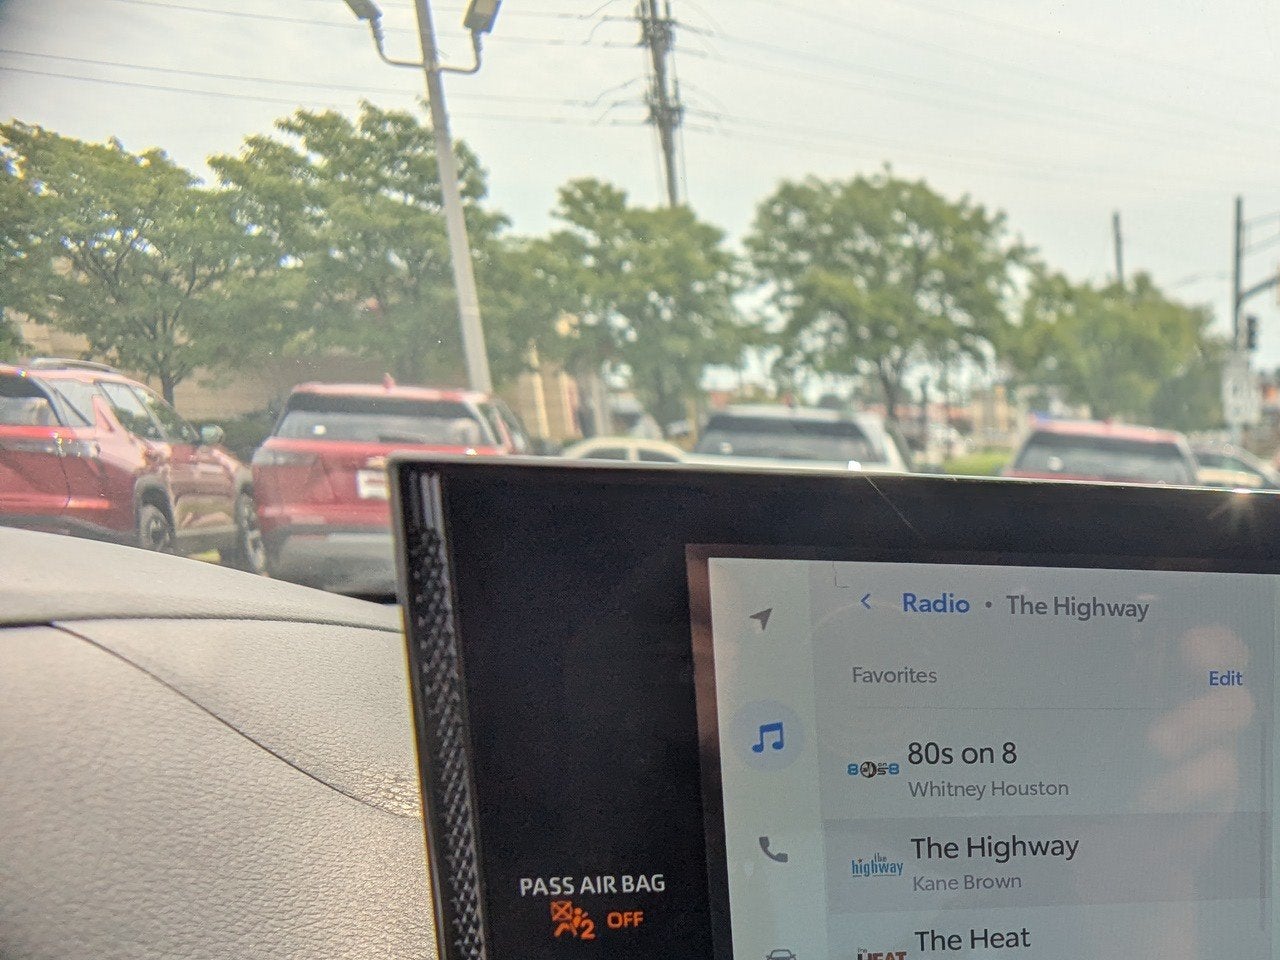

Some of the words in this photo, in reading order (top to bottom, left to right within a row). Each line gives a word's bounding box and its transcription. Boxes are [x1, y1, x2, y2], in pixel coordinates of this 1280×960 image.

[903, 593, 970, 613] Radio
[1006, 595, 1048, 615] The
[1054, 596, 1150, 622] Highway
[852, 666, 937, 683] Favorites
[1209, 671, 1243, 686] Edit
[908, 742, 954, 765] 80s
[961, 747, 994, 764] on
[1002, 742, 1017, 764] 8
[908, 781, 986, 800] Whitney
[991, 781, 1069, 796] Houston
[910, 836, 959, 859] The
[967, 835, 1080, 863] Highway
[851, 859, 904, 877] highway
[520, 876, 575, 897] PASS
[580, 875, 618, 894] AIR
[621, 873, 666, 894] BAG
[913, 876, 959, 891] Kane
[964, 875, 1022, 890] Brown
[607, 911, 644, 929] OFF
[914, 930, 962, 951] The
[970, 928, 1031, 949] Heat
